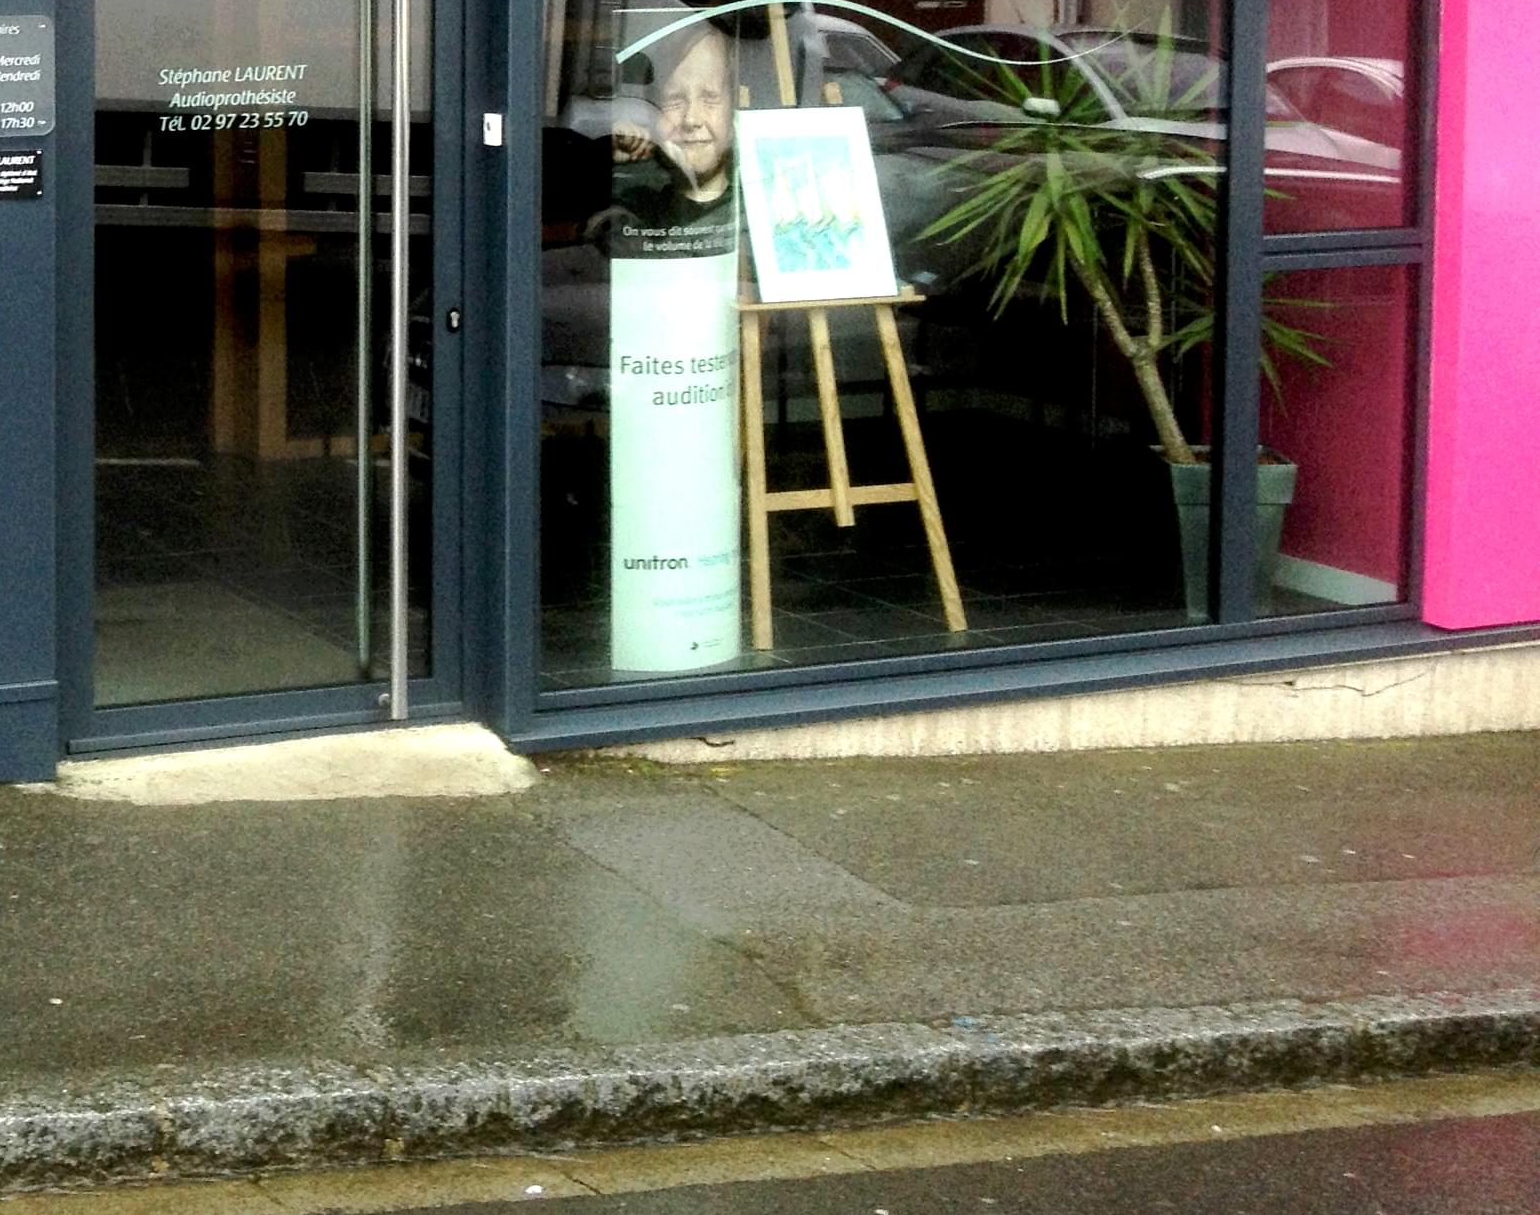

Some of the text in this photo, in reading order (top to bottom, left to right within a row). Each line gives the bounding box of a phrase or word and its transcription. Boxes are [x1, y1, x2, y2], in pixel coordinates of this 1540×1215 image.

[158, 64, 308, 88] Stéphane LAURENT
[0, 101, 35, 114] 12h00
[169, 89, 297, 110] Audioprothésiste
[0, 117, 35, 129] 17h30
[190, 114, 212, 131] 02
[214, 113, 238, 130] 97
[238, 112, 260, 129] 23
[262, 111, 285, 128] 55
[287, 110, 309, 127] 70
[641, 228, 667, 237] vous
[620, 355, 685, 375] Faites
[623, 555, 689, 571] unitron
